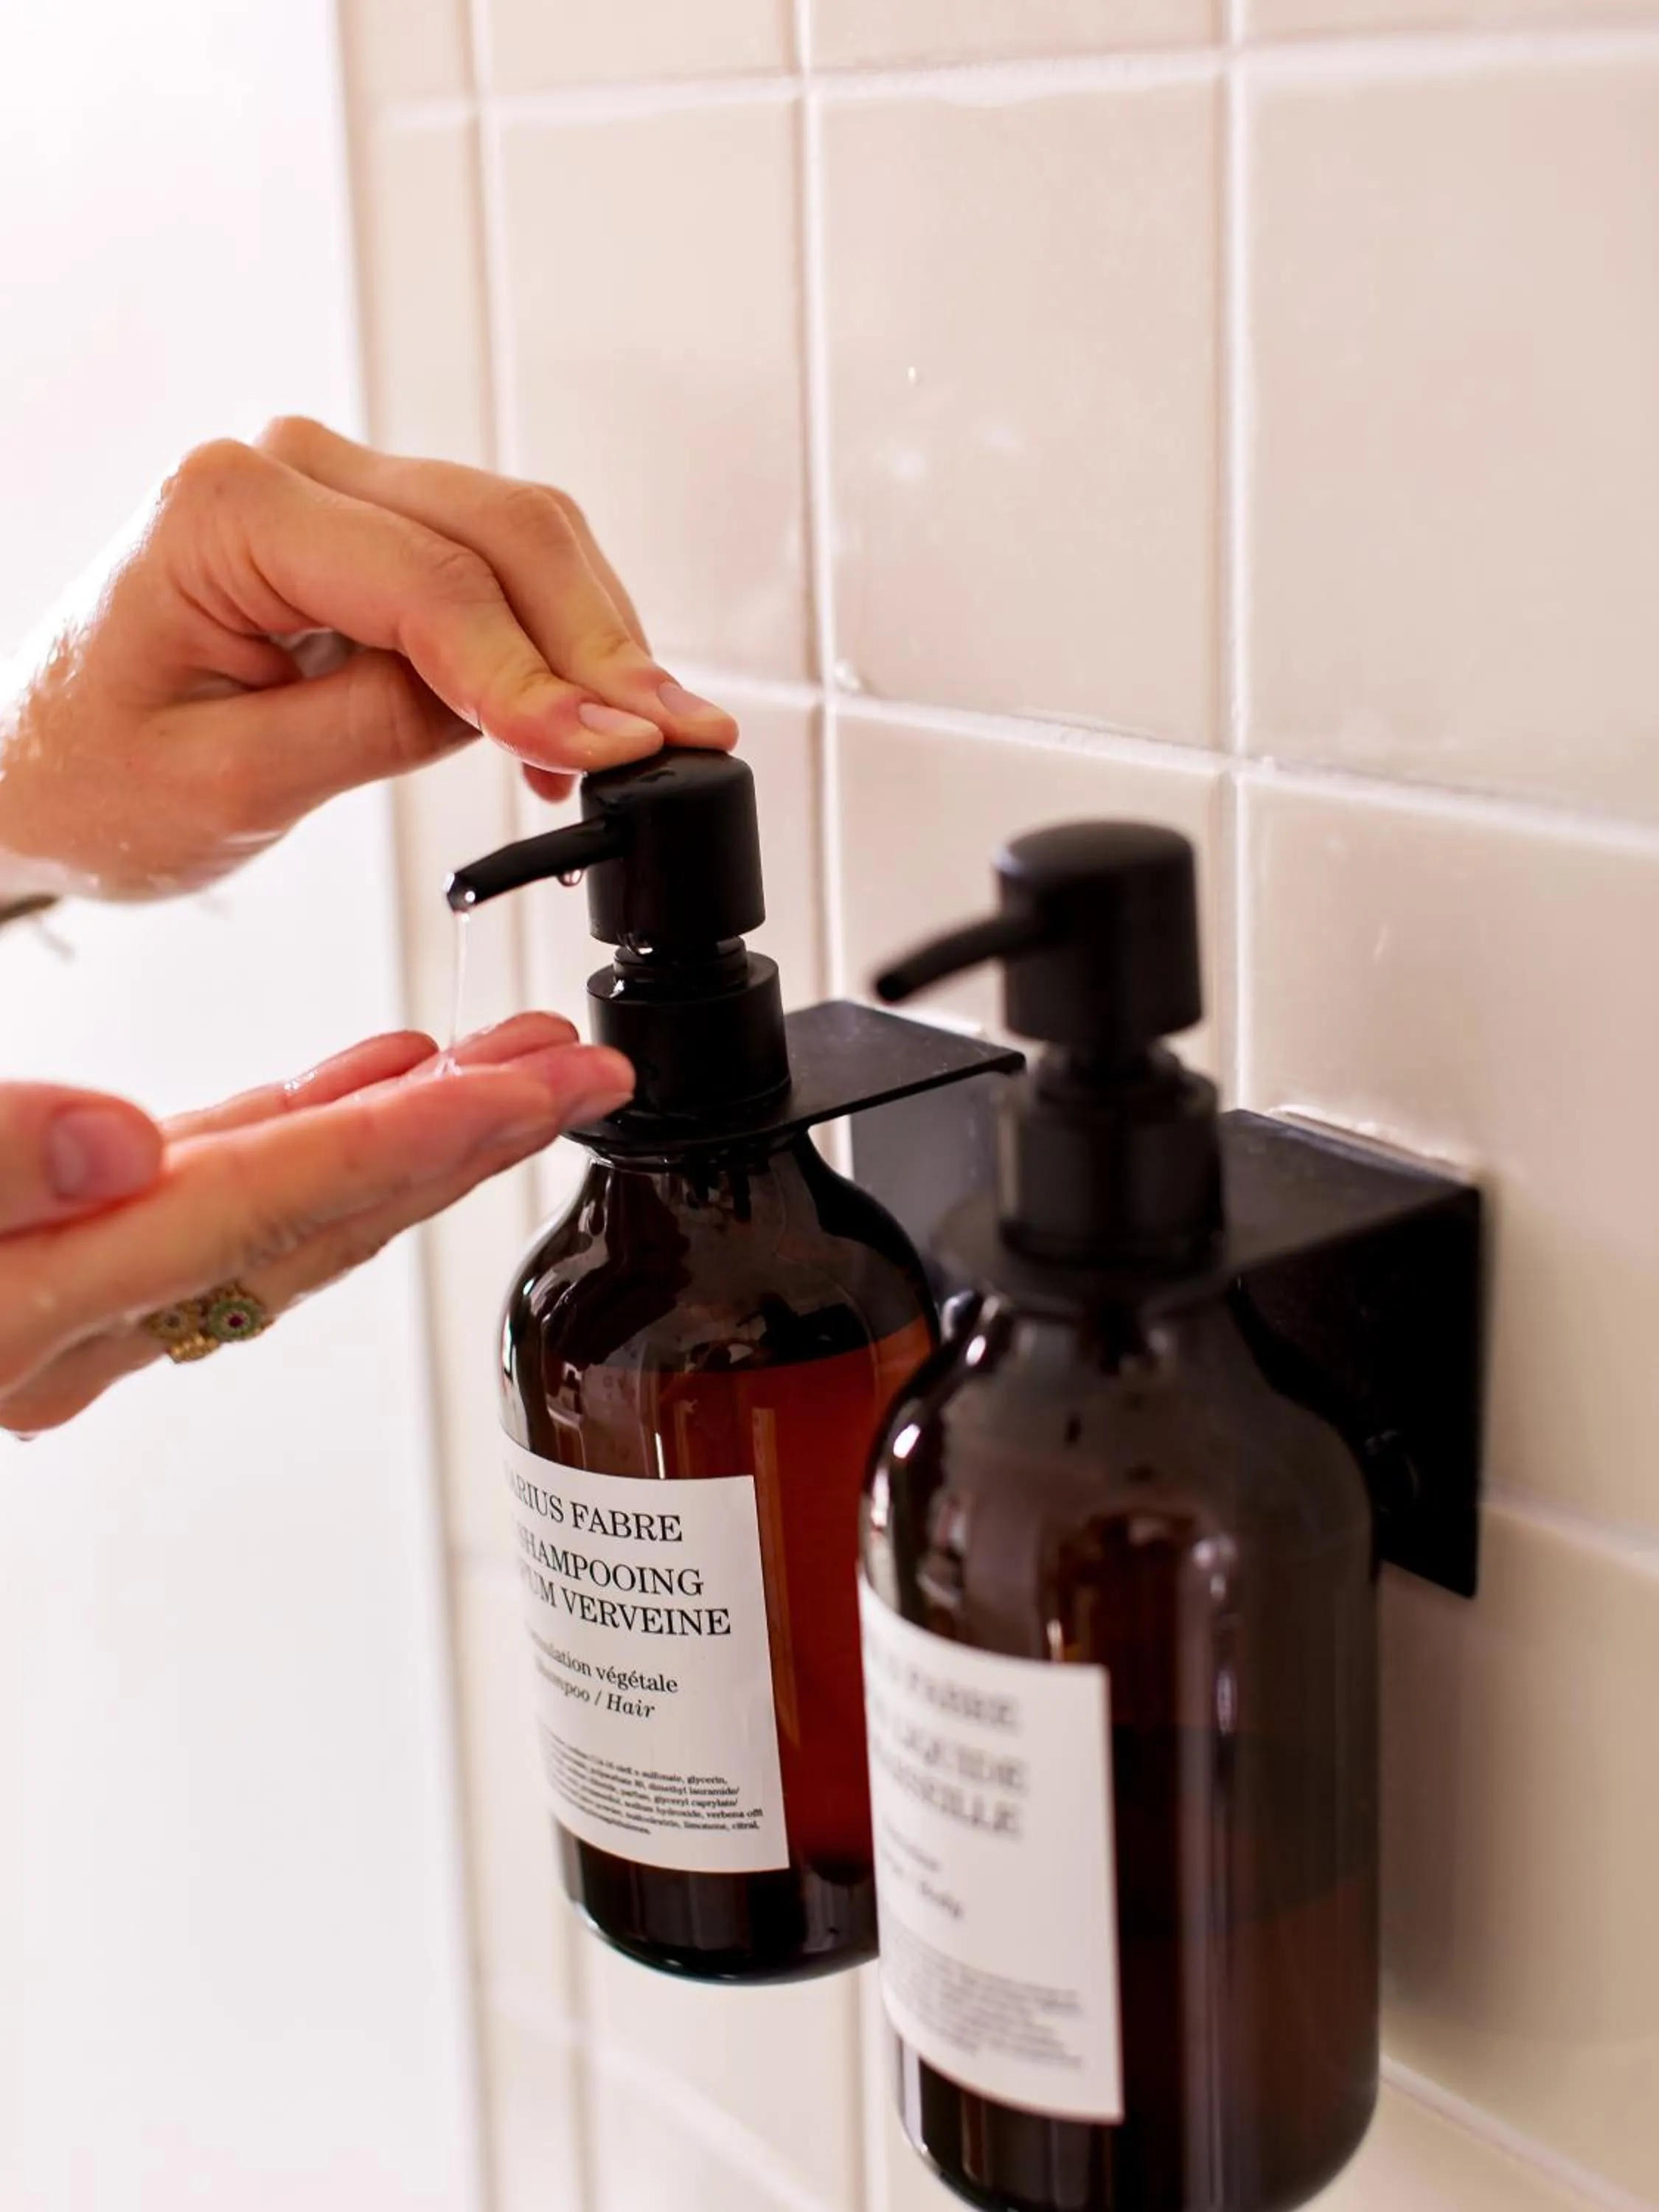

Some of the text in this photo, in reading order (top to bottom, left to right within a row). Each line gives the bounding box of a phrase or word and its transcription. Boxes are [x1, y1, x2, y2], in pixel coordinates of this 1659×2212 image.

[570, 1501, 683, 1543] FABRE
[560, 1586, 731, 1636] VERVEINE
[596, 1666, 678, 1694] végétale
[607, 1693, 655, 1719] Hair
